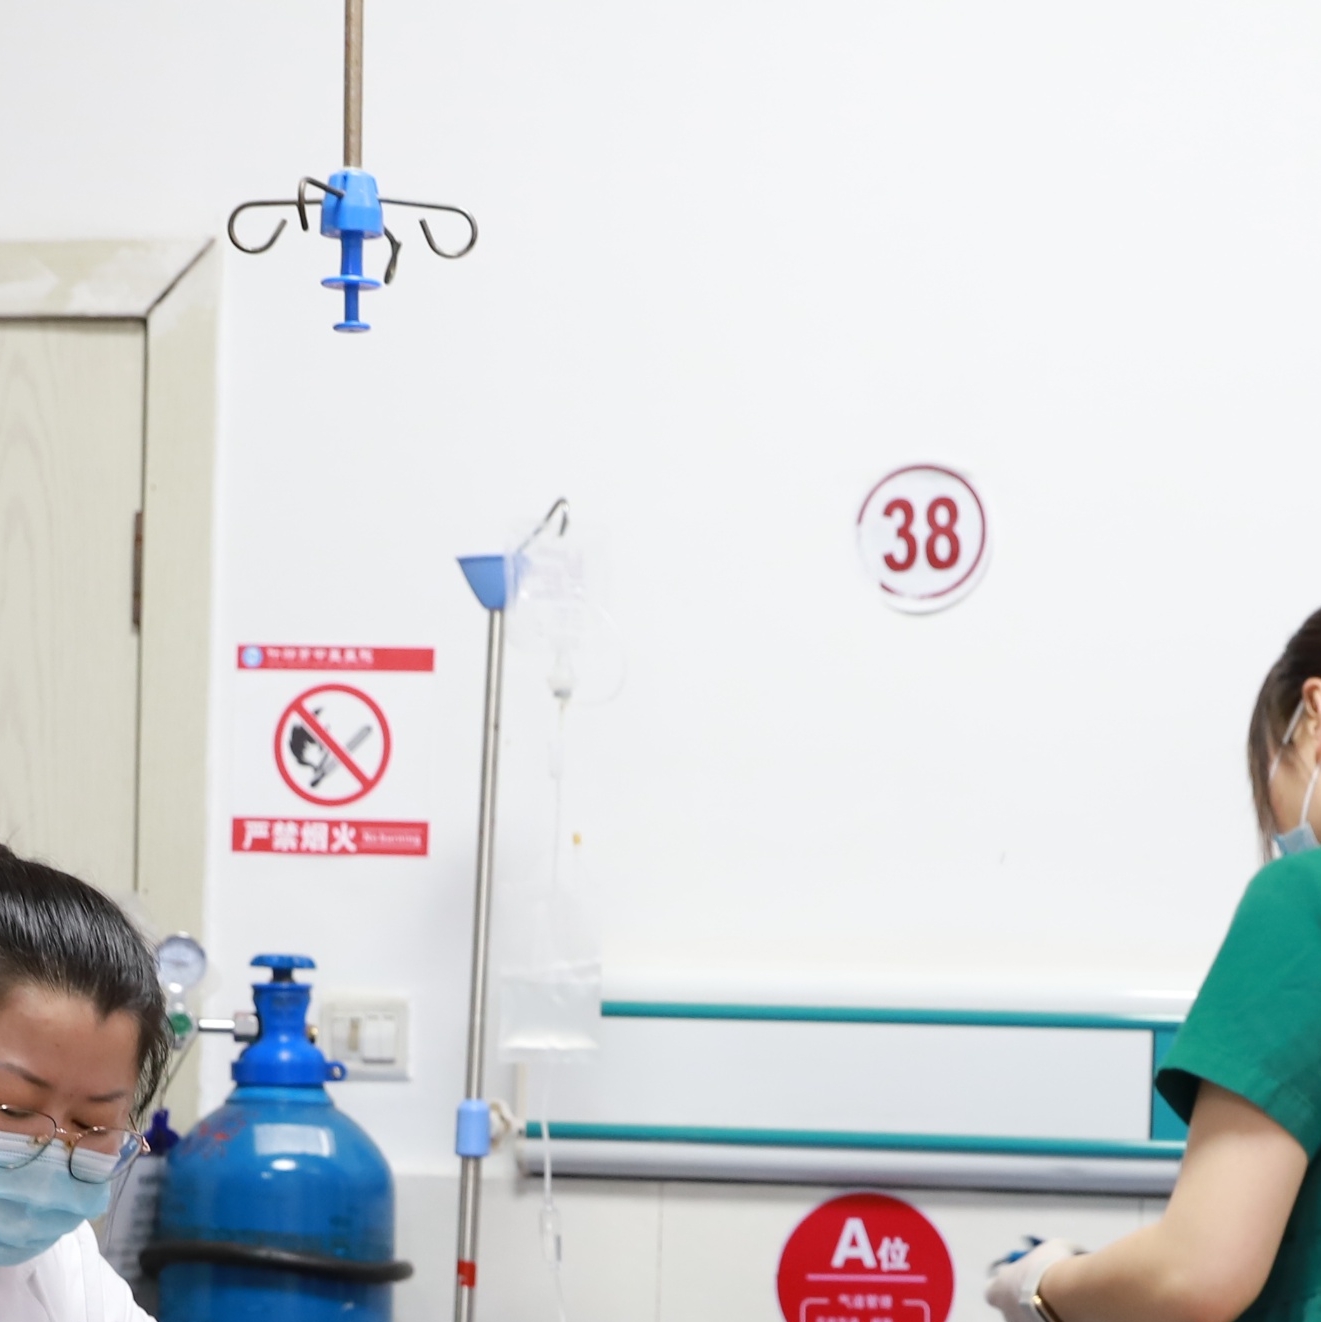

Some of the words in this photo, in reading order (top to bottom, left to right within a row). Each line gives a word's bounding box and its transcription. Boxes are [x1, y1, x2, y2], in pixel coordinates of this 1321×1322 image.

[883, 497, 960, 572] 38
[242, 820, 358, 853] 严禁烟火
[830, 1217, 911, 1272] A位
